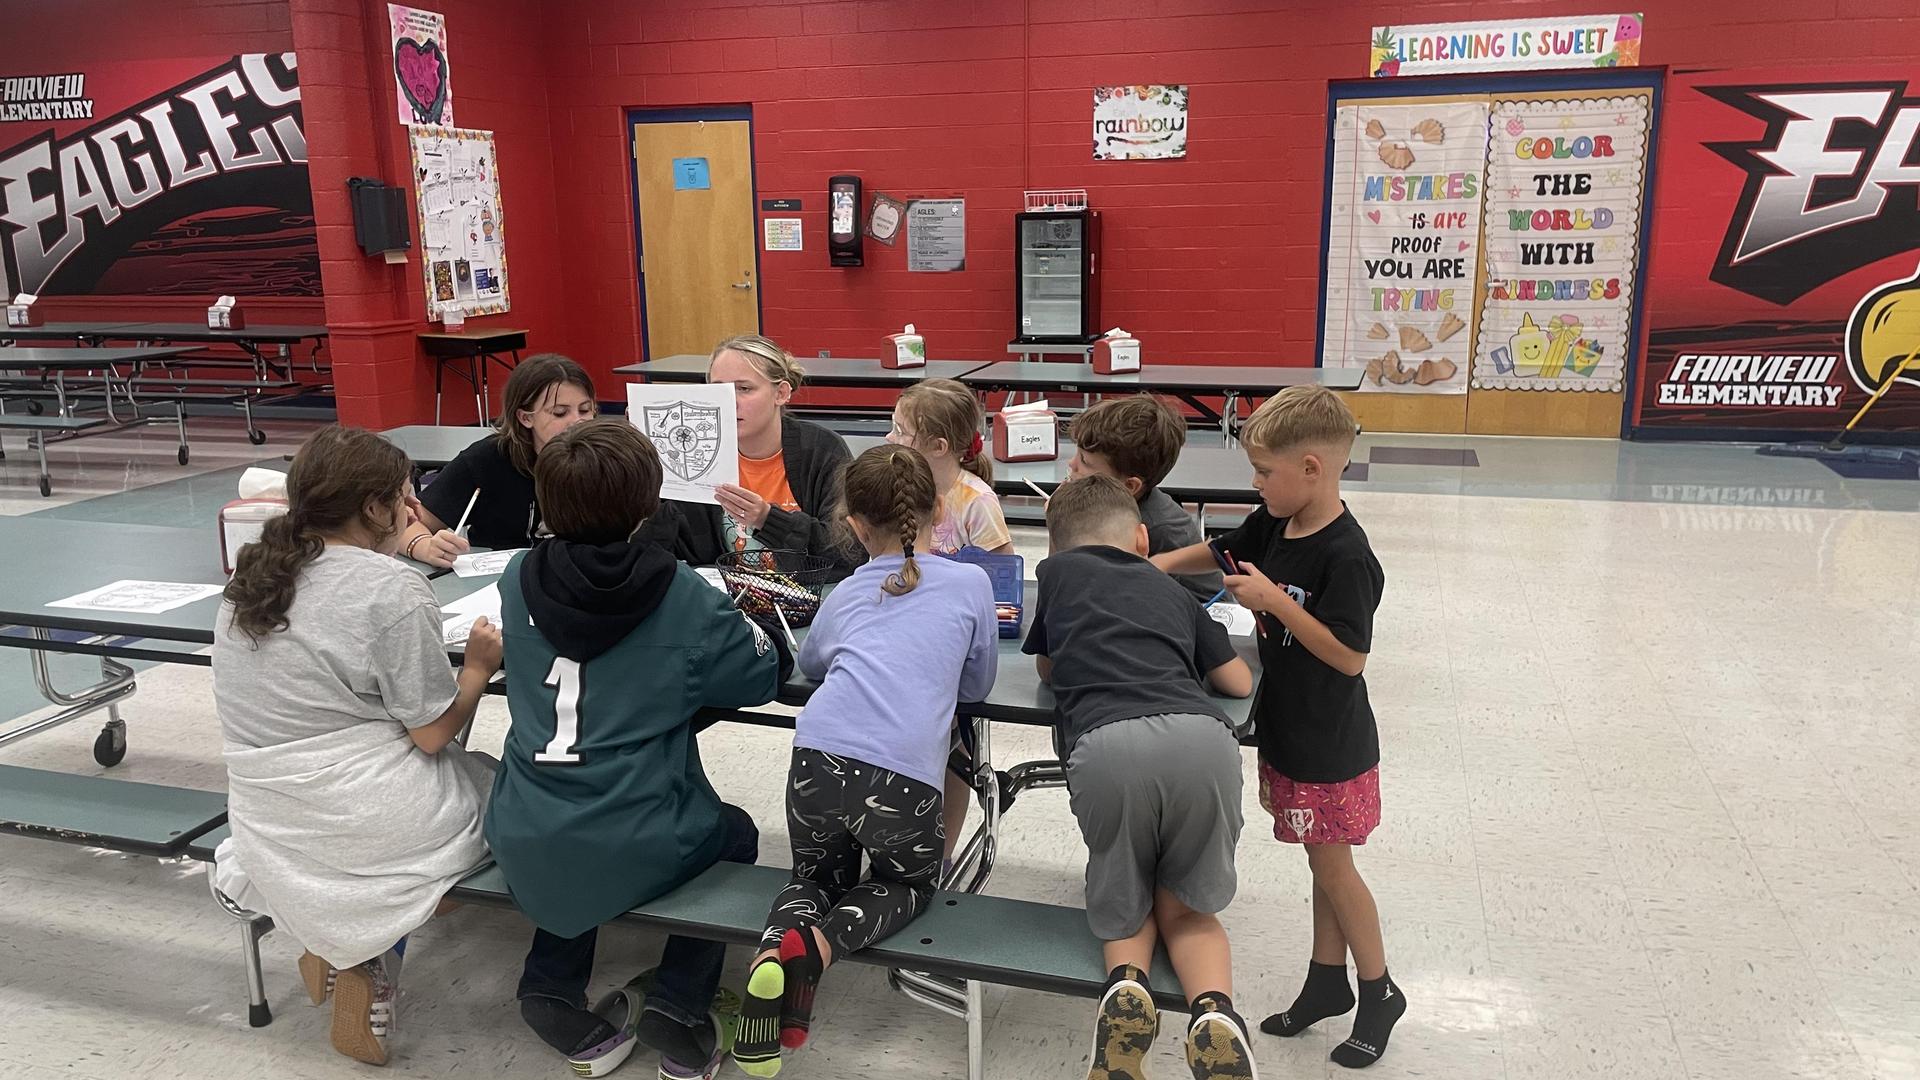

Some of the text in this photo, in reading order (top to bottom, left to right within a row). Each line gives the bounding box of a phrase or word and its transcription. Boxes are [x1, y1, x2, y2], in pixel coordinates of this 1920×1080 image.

[1398, 28, 1608, 62] LEARNING IS SWEET
[0, 100, 93, 121] LEMENTARY
[1096, 113, 1184, 134] rainbow
[1515, 135, 1615, 160] COLOR
[1533, 173, 1592, 196] THE
[1433, 211, 1468, 230] are
[1508, 207, 1614, 231] WORLD
[1520, 242, 1595, 266] WITH
[1421, 257, 1466, 280] ARE
[1370, 287, 1455, 312] TRYING
[1492, 278, 1621, 301] KINDNESS
[1669, 354, 1837, 383] FAIRVIEW
[1658, 383, 1842, 407] ELEMENTARY
[1021, 435, 1041, 445] Eagles
[534, 656, 580, 762] 1
